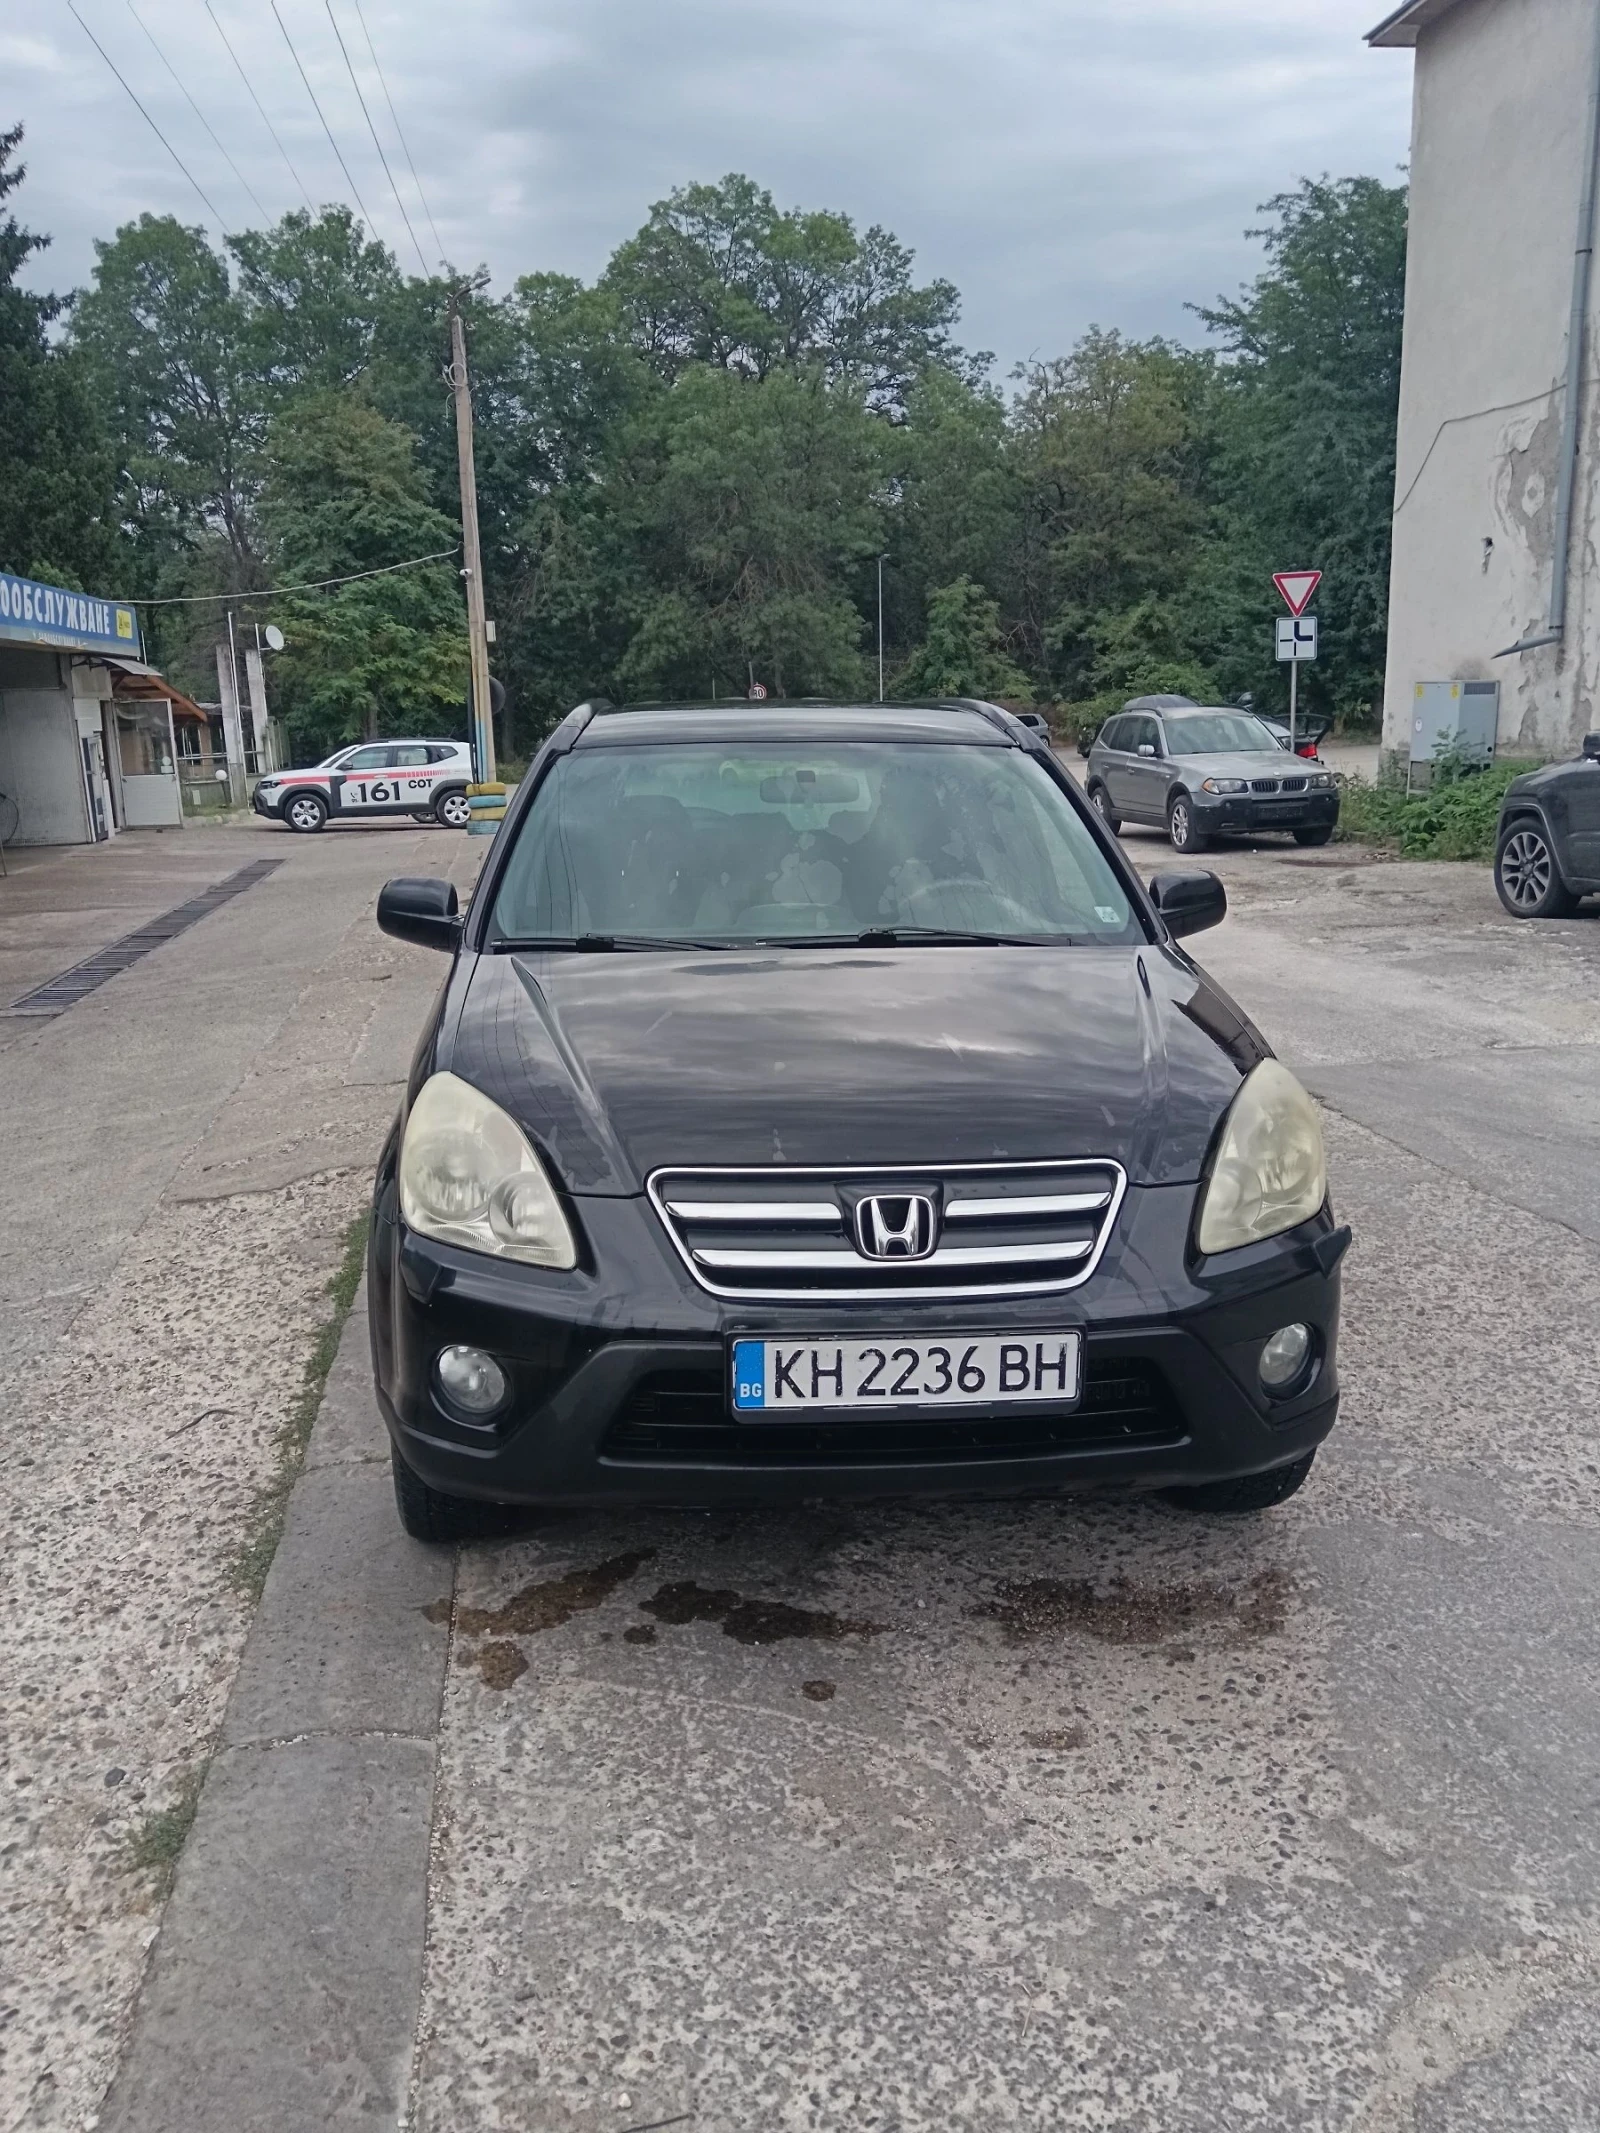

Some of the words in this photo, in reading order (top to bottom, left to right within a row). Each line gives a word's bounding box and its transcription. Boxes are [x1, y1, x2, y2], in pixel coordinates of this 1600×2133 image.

[357, 780, 400, 803] 161
[408, 778, 433, 789] СОТ
[774, 1347, 843, 1399] KH
[856, 1345, 986, 1397] 2236
[999, 1342, 1068, 1393] BH
[739, 1383, 762, 1399] BG
